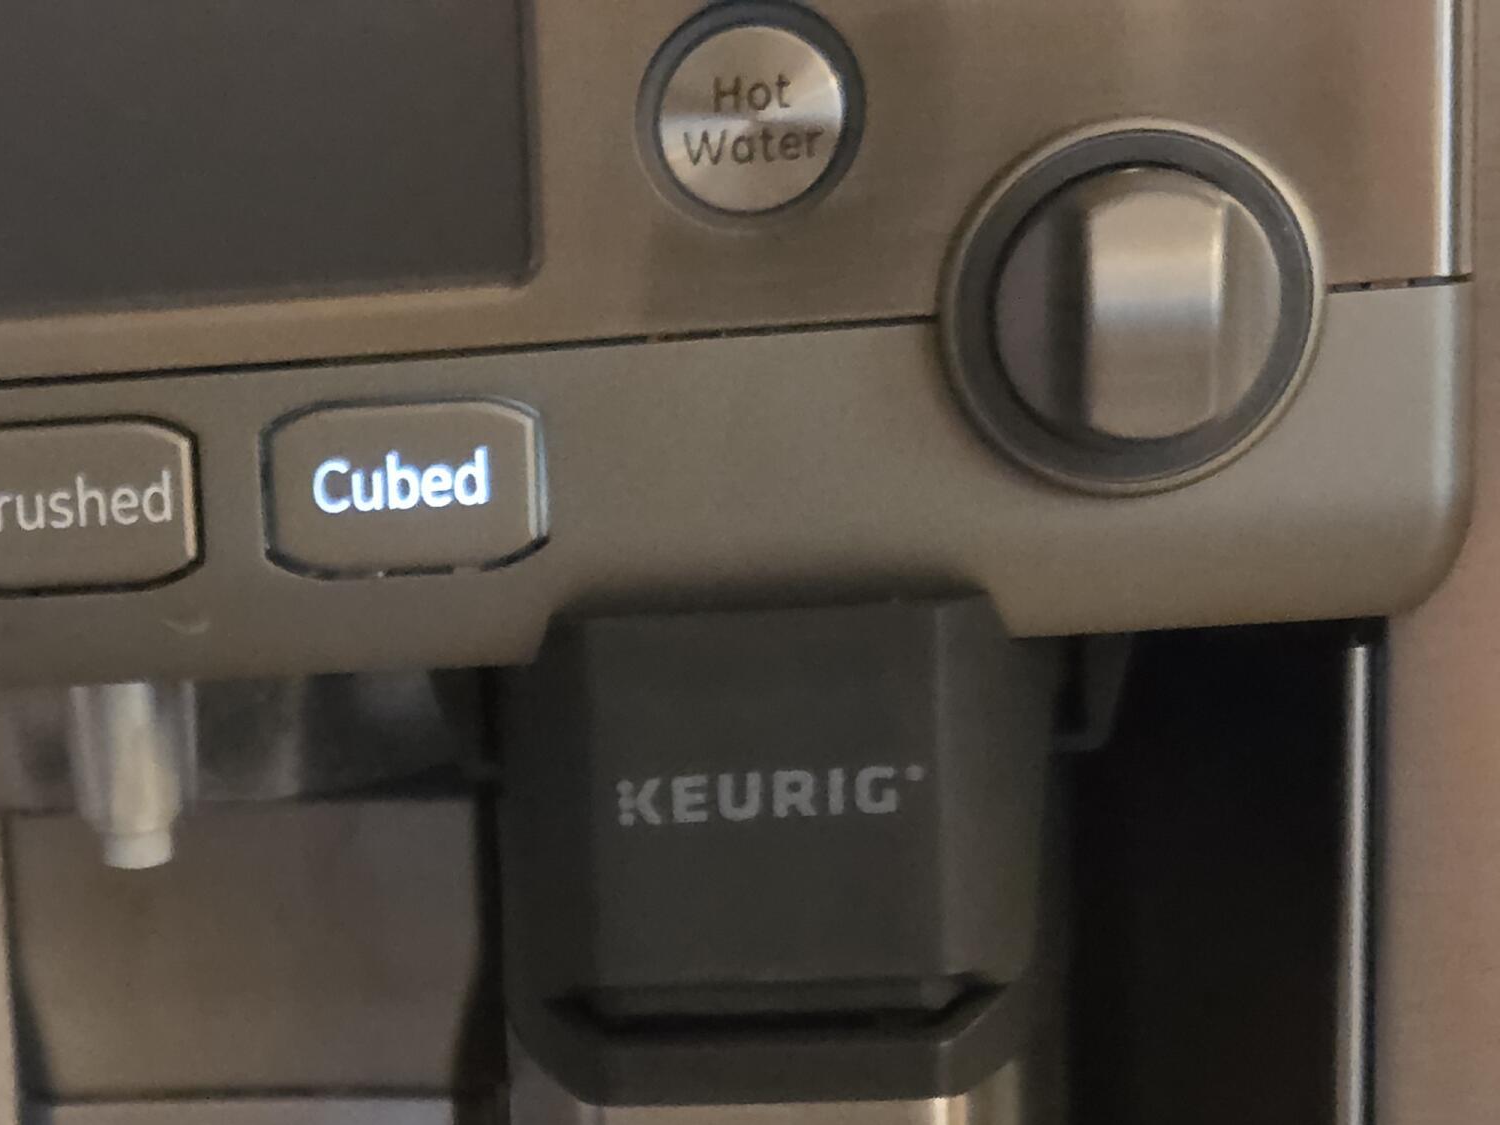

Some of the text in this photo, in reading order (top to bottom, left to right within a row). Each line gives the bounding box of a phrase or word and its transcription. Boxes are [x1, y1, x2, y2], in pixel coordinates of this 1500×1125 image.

[712, 73, 792, 113] Hot
[683, 124, 825, 166] Water
[311, 445, 491, 515] Cubed
[615, 766, 898, 826] KEURIG
